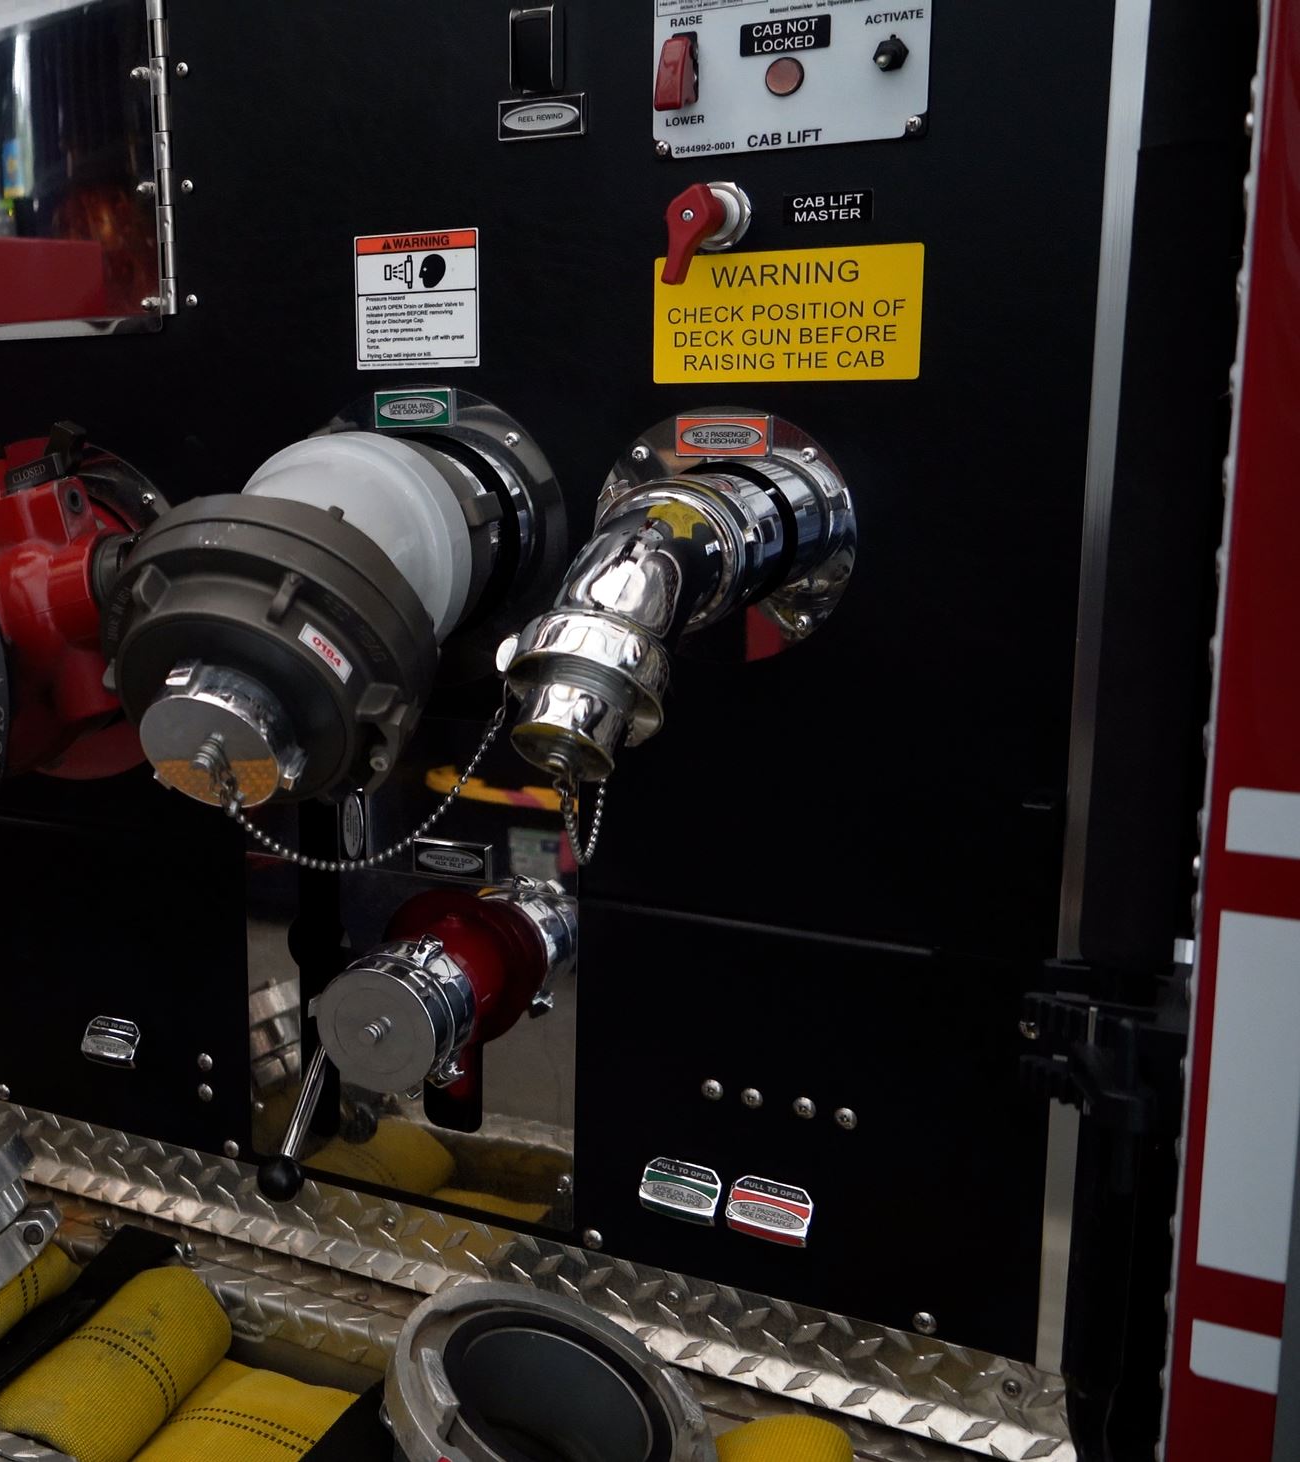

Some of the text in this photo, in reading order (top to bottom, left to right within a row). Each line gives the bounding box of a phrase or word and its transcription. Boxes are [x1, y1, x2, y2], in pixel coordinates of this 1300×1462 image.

[670, 15, 703, 28] RAISE
[864, 9, 924, 25] ACTIVATE
[752, 18, 819, 38] CAB NOT
[754, 35, 815, 53] LOCKED
[537, 113, 563, 121] REWIND
[665, 114, 705, 127] LOWER
[747, 129, 822, 148] CAB LIFT
[675, 141, 736, 155] 2644992-0001
[792, 193, 864, 209] CAB LIFT
[794, 208, 862, 223] MASTER
[392, 235, 450, 249] WARNING
[711, 259, 860, 289] WARNING
[667, 298, 906, 325] CHECK POSITION OF
[674, 324, 897, 348] DECK GUN BEFORE
[684, 350, 885, 371] RAISING THE CAB
[12, 463, 46, 483] CLOSED
[312, 636, 342, 667] 0184
[119, 1024, 135, 1032] OPEN
[657, 1161, 713, 1182] PULL TO OPEN
[743, 1180, 804, 1200] PULL TO OPEN
[739, 1209, 793, 1228] SIDE DISCHARGE
[757, 1208, 798, 1223] PASSENGER
